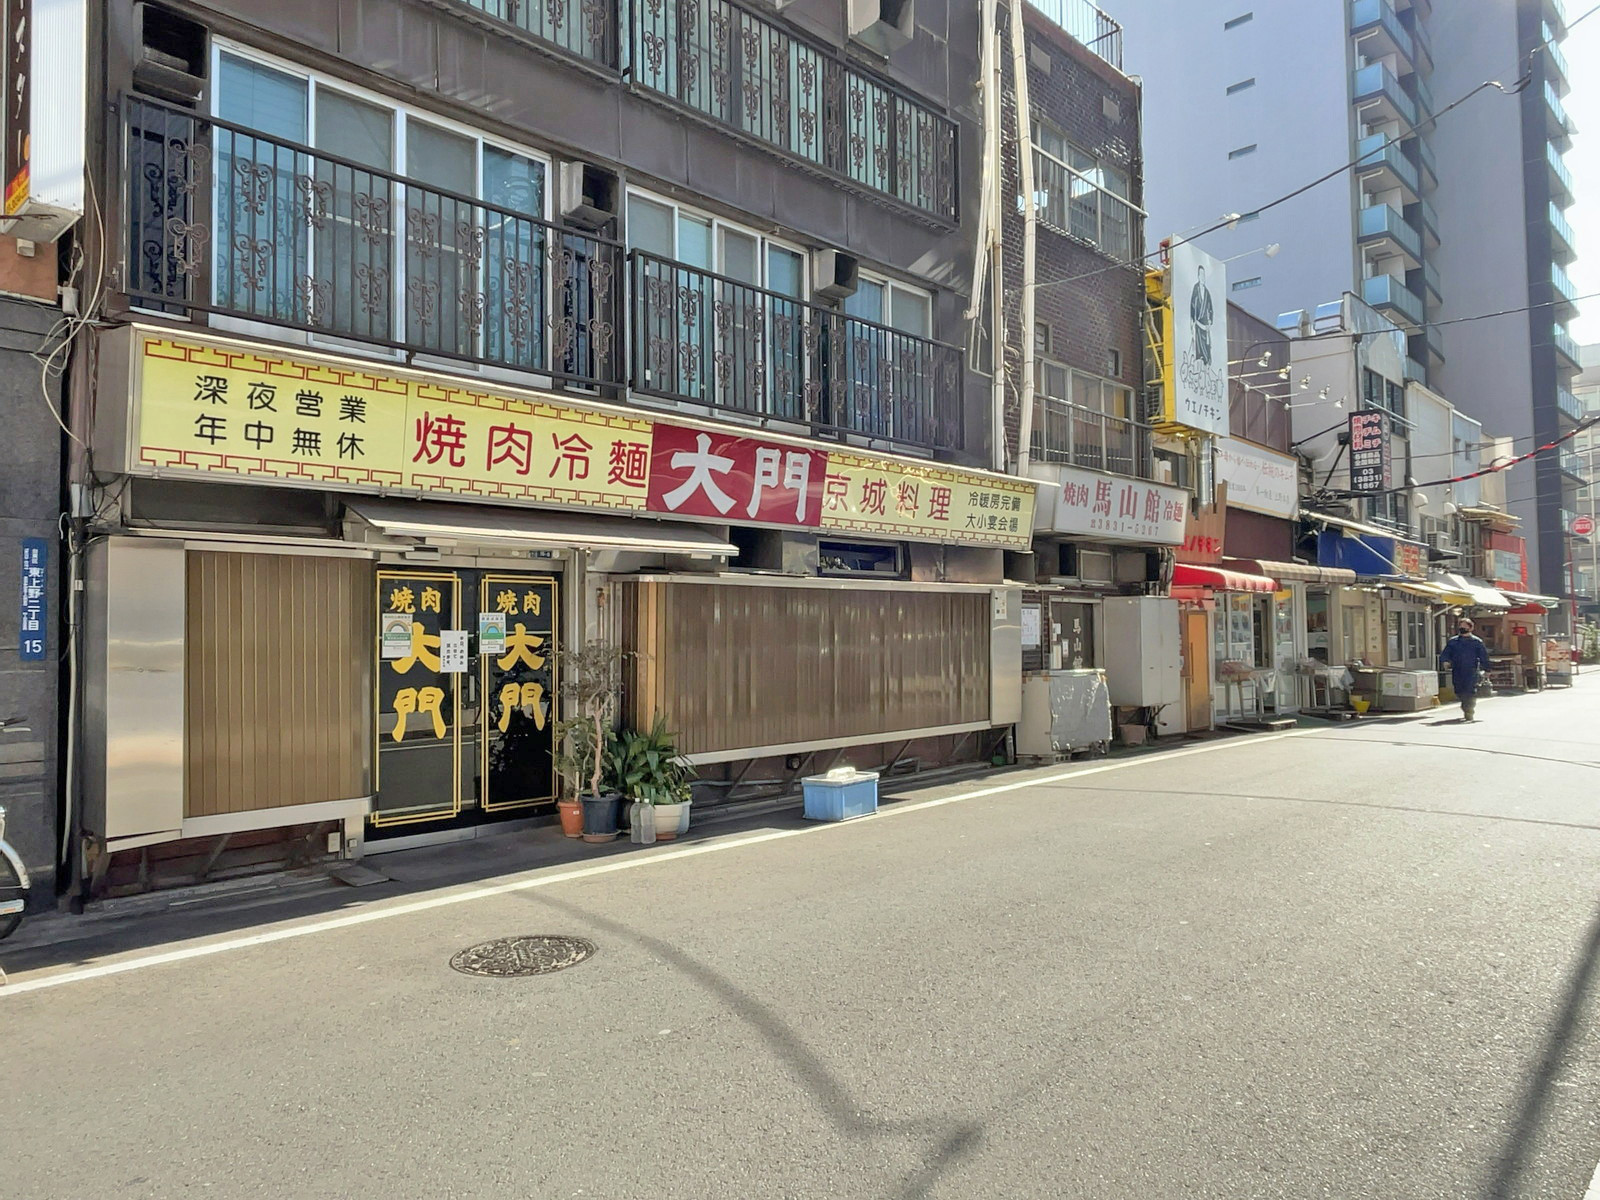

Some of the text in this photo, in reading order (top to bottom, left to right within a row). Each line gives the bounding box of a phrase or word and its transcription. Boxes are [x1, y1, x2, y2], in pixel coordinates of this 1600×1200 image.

[193, 375, 367, 424] 深夜営業
[193, 413, 366, 461] 年中無休
[662, 433, 812, 524] 大門
[822, 471, 952, 521] 京城料理
[967, 491, 1021, 512] 冷暖房完備
[1063, 481, 1089, 508] 焼肉
[1092, 478, 1161, 524] 馬山館
[965, 513, 1019, 533] 大小宴会場
[27, 567, 41, 631] 東上野二丁目
[389, 586, 442, 614] 焼肉
[496, 589, 542, 616] 焼肉
[24, 640, 42, 653] 15
[496, 622, 545, 733] 大門
